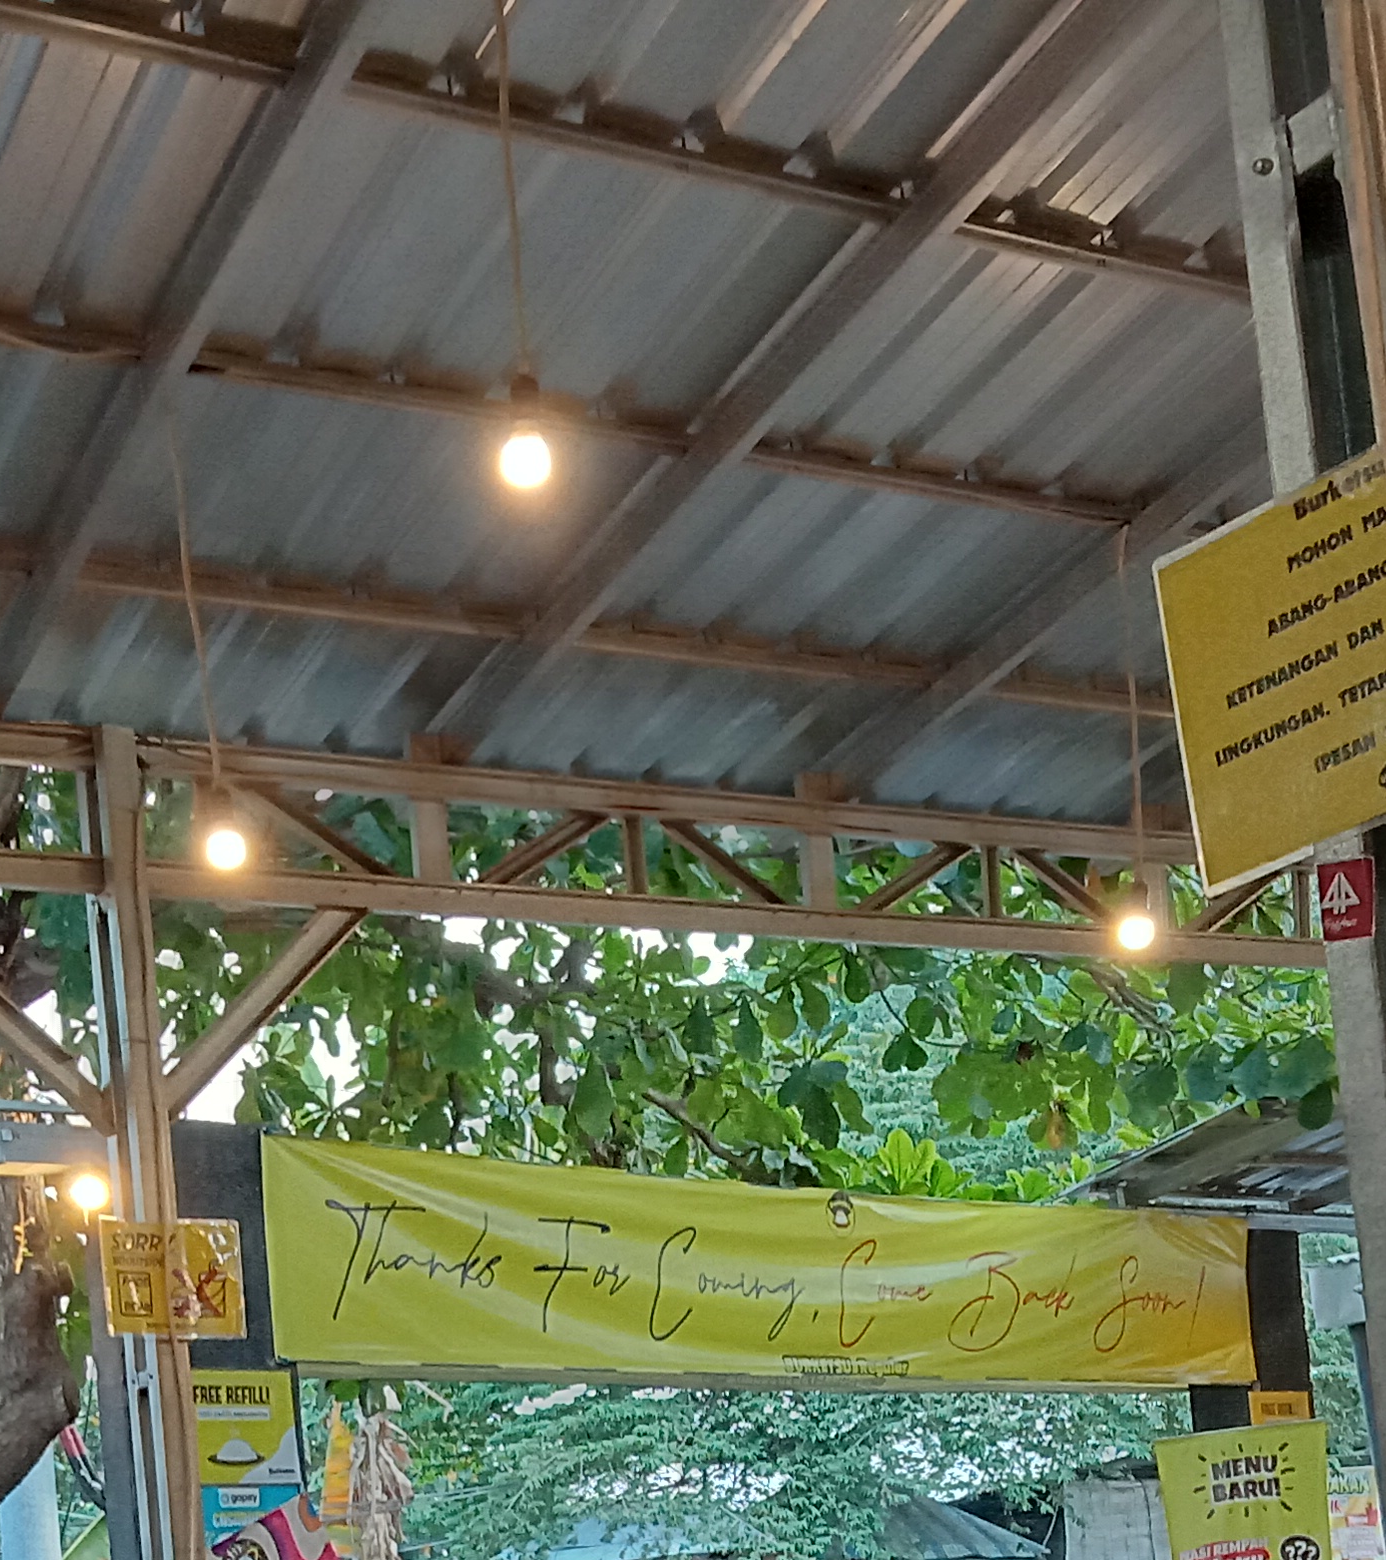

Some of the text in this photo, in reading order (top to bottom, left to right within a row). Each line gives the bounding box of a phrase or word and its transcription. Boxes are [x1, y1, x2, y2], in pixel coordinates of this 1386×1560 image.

[1287, 525, 1353, 573] MOHON
[1226, 641, 1339, 709] KETENANGAN
[1347, 618, 1385, 649] DAN
[1215, 702, 1330, 767] LINGKUNGAN.
[325, 1200, 502, 1320] Thanks
[534, 1216, 630, 1333] For
[839, 1239, 932, 1348] Come
[947, 1250, 1077, 1352] Back
[193, 1385, 271, 1405] FREE REFILL!
[1212, 1454, 1278, 1481] MENU
[1212, 1477, 1281, 1503] BARU!
